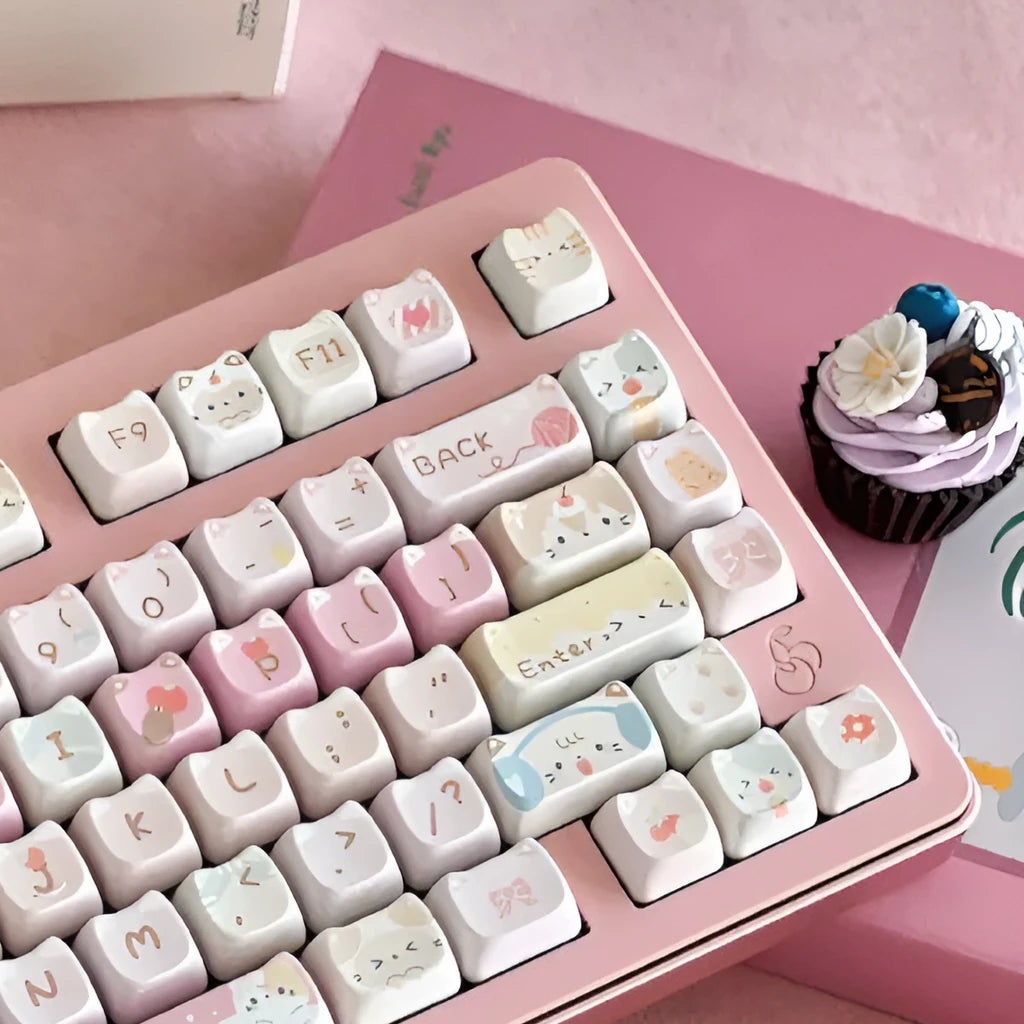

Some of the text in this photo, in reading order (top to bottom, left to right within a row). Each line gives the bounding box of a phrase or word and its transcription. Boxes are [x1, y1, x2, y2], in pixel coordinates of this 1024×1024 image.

[294, 337, 346, 371] F11
[107, 421, 148, 450] F9
[412, 431, 493, 476] BACK
[350, 477, 369, 495] +
[334, 516, 355, 532] =
[141, 596, 165, 619] 0
[37, 641, 57, 665] 9
[251, 648, 280, 682] P
[516, 637, 593, 679] Enter
[45, 729, 75, 761] I
[223, 767, 257, 793] L
[439, 779, 463, 805] ?
[124, 811, 153, 842] K
[27, 860, 55, 895] J
[124, 924, 161, 960] M
[24, 969, 58, 1008] N
